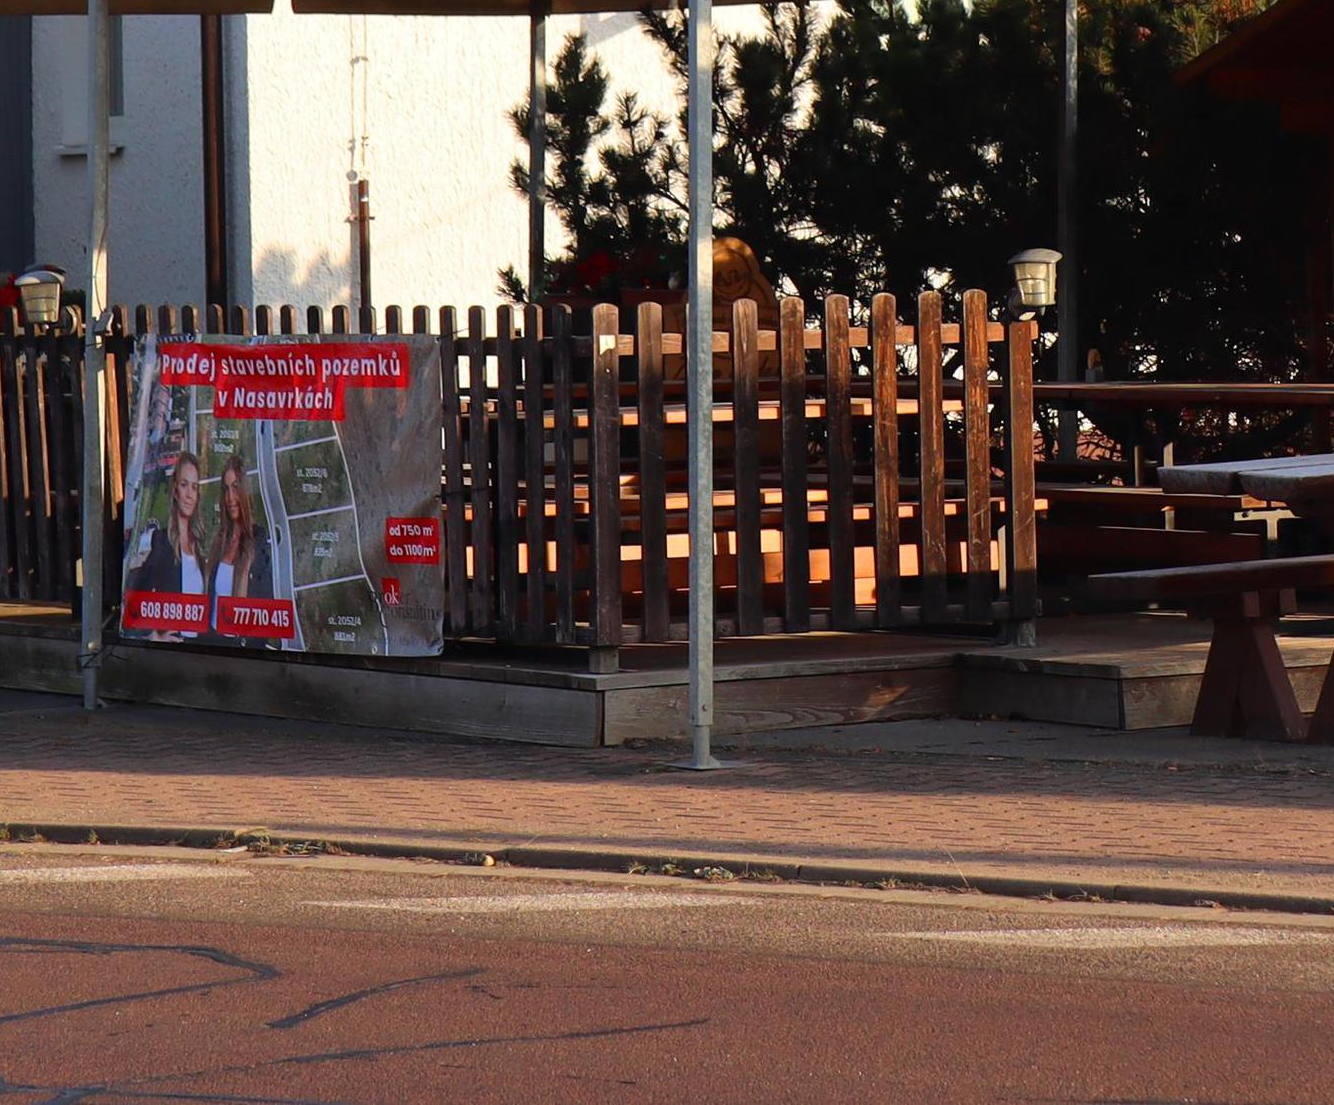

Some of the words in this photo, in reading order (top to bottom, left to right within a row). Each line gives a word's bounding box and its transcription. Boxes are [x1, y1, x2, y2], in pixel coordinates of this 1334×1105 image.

[162, 353, 216, 382] Prodej
[221, 351, 316, 377] stavebních
[322, 351, 401, 382] pozemků
[218, 390, 227, 408] v
[233, 387, 334, 410] Nasavrkách
[389, 524, 401, 537] od
[402, 525, 421, 537] 750
[390, 544, 403, 557] do
[384, 584, 399, 605] ok
[140, 600, 162, 619] 608
[162, 602, 182, 620] 898
[184, 604, 205, 622] 887
[232, 607, 254, 625] 777
[252, 608, 269, 626] 710
[271, 609, 290, 627] 415
